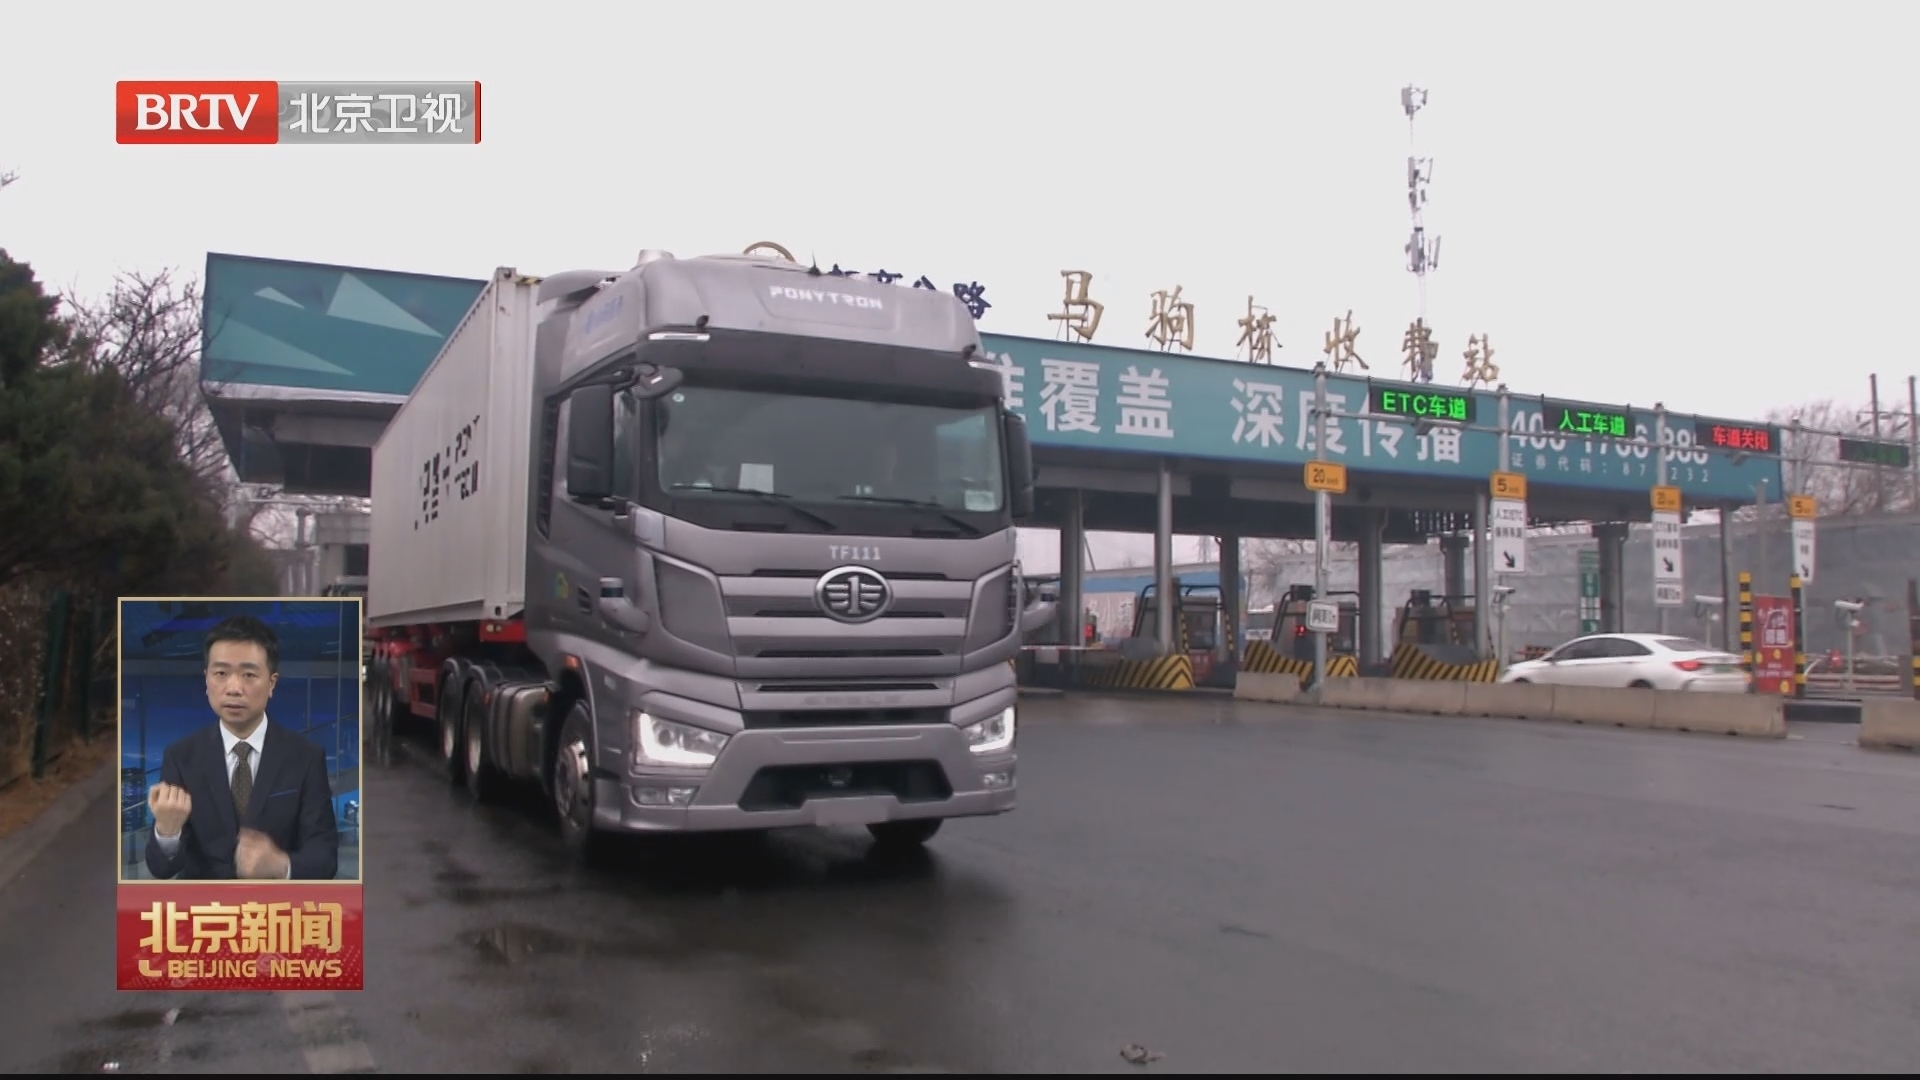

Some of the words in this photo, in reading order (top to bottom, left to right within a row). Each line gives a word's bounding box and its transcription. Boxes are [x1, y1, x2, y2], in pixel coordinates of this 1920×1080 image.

[769, 285, 883, 310] PONYTRON
[1382, 391, 1467, 420] ETC车道
[1559, 409, 1625, 436] 人工车道
[1712, 425, 1769, 451] 车道关闭
[1497, 478, 1507, 492] 5
[829, 545, 881, 560] TF111
